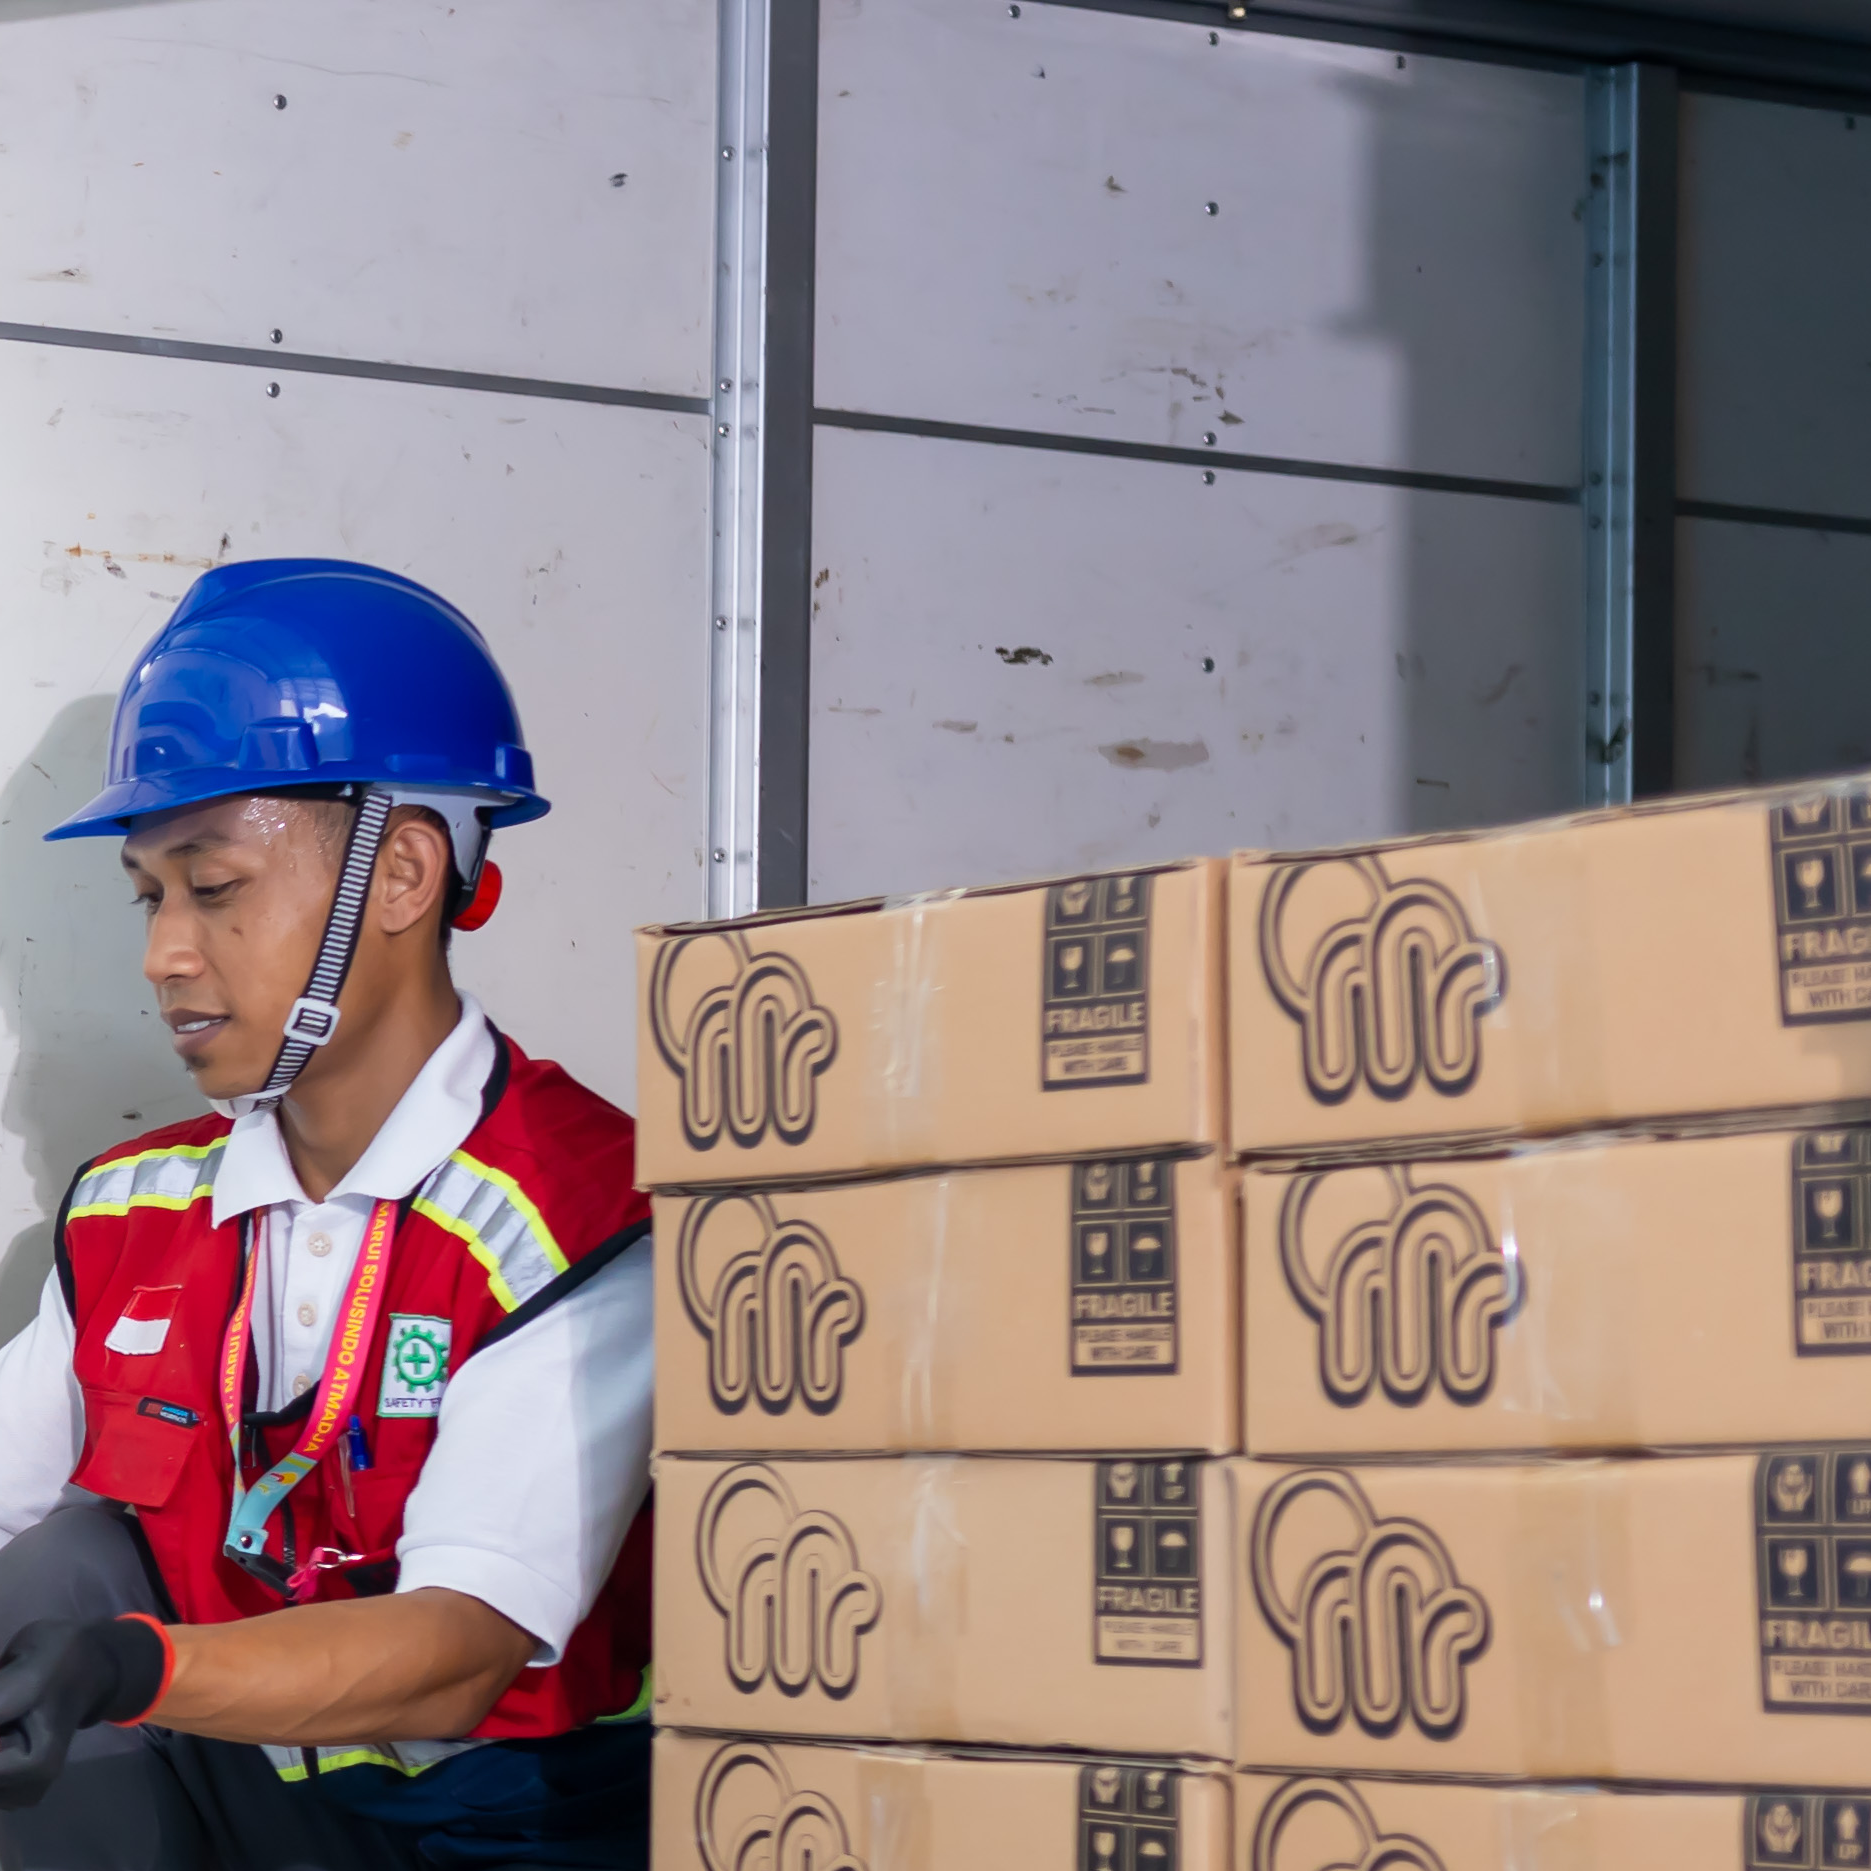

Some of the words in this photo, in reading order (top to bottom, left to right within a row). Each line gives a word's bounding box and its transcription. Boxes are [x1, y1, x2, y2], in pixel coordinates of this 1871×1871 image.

[1784, 928, 1871, 961] FRAG
[1049, 1003, 1145, 1032] FRAGILE
[366, 1202, 391, 1260] MARUI
[337, 1263, 379, 1365] SOLUSINDO
[1076, 1292, 1173, 1318] FRAGILE
[224, 1335, 241, 1393] MARUI
[303, 1367, 351, 1452] ATMADJA
[384, 1397, 423, 1408] SAFETY
[1099, 1586, 1199, 1613] FRAGILE
